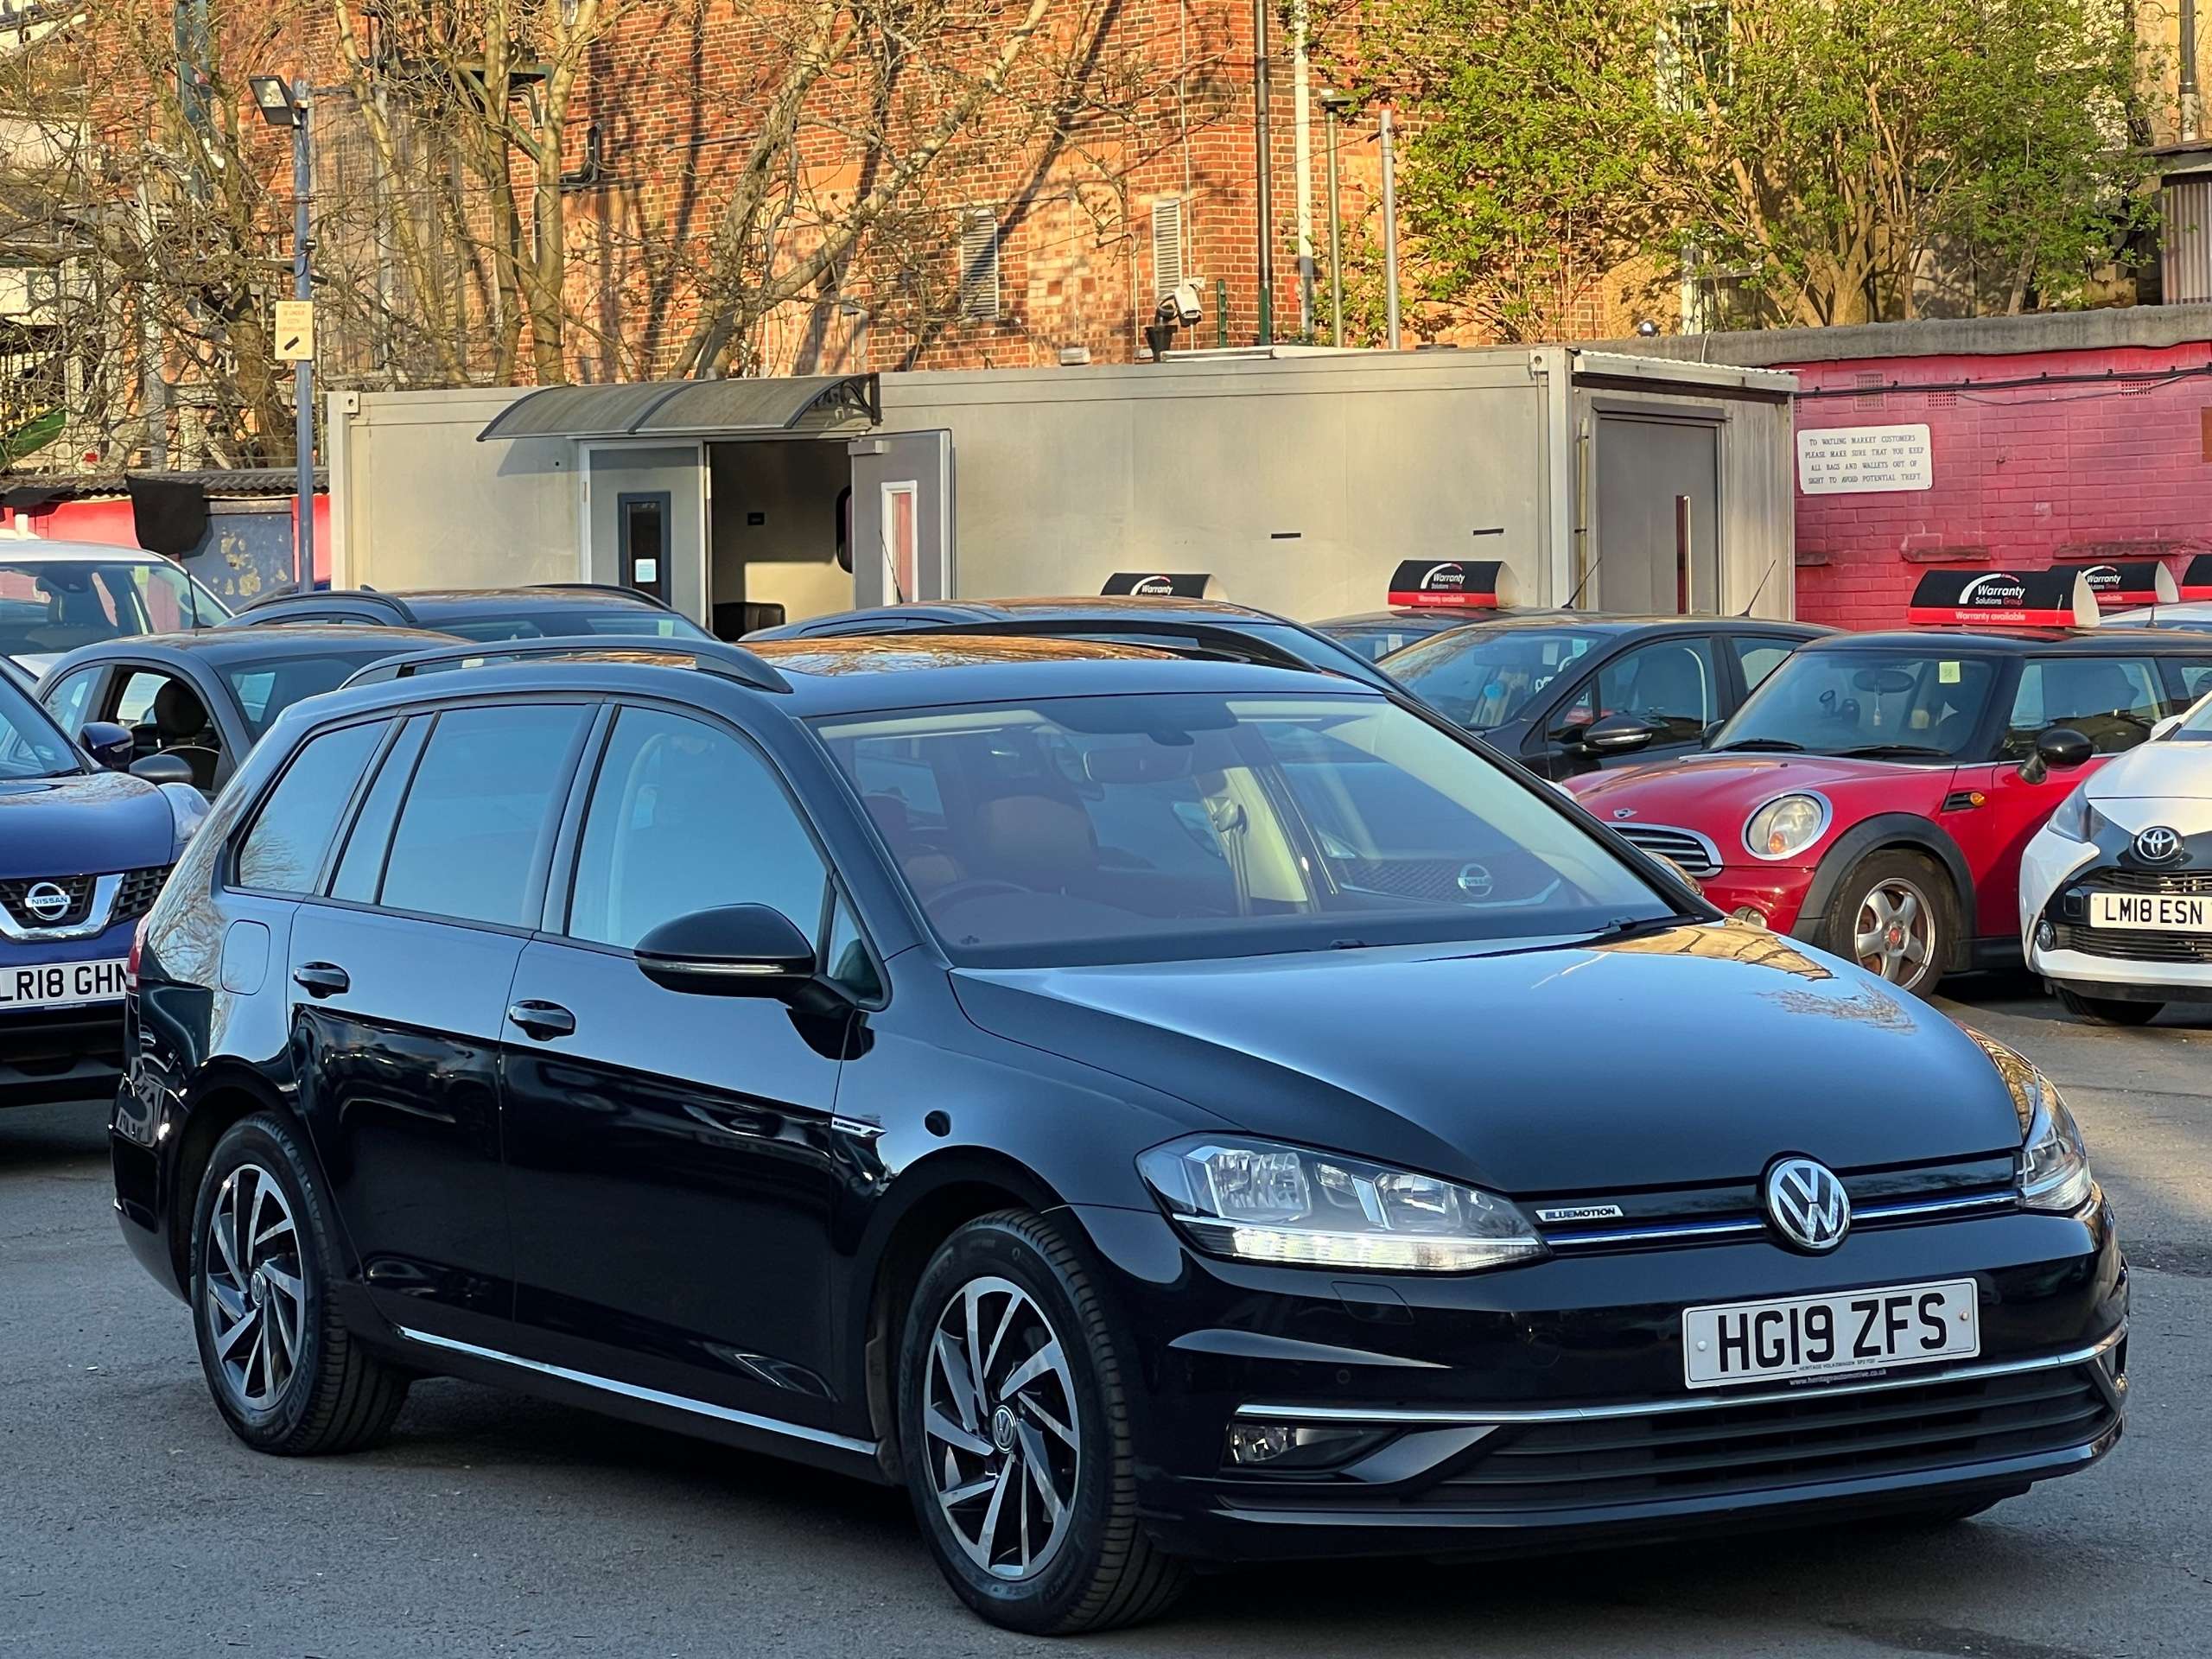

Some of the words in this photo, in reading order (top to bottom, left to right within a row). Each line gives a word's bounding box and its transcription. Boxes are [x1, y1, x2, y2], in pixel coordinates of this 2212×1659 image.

[1433, 573, 1465, 585] Warranty
[2087, 575, 2121, 584] Warranty
[1141, 584, 1173, 595] Warranty
[1977, 585, 2025, 599] Warranty
[1975, 596, 2002, 606] Solutions
[2003, 596, 2023, 606] Group
[1955, 610, 1991, 623] Warranty
[1991, 610, 2026, 621] available
[2105, 897, 2152, 923] LM18
[2159, 899, 2202, 925] ESN
[1545, 1207, 1616, 1220] BLUEMOTION
[1718, 1305, 1835, 1373] HG19
[1851, 1292, 1948, 1358] ZFS
